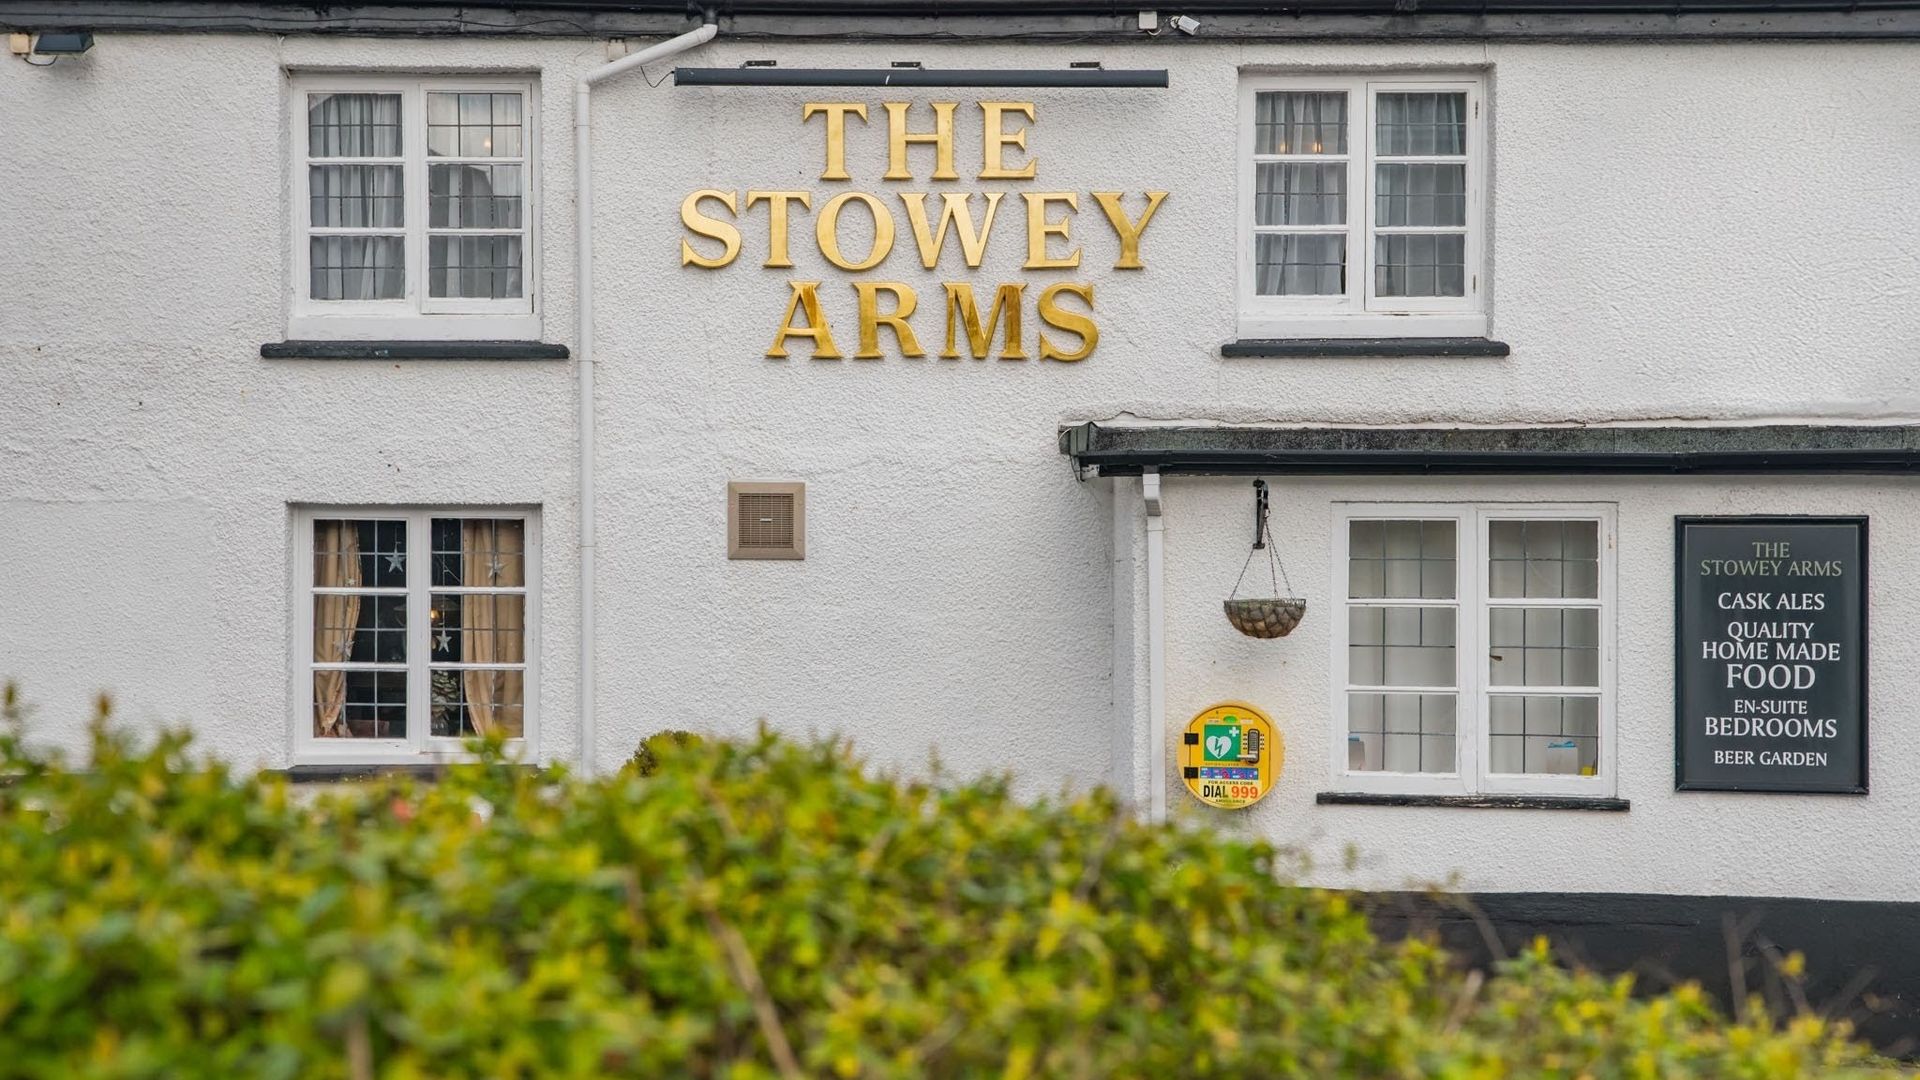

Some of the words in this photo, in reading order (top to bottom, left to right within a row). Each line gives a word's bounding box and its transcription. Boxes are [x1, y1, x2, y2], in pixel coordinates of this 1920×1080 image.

[803, 101, 1038, 181] THE
[680, 190, 1170, 271] STOWEY
[765, 281, 1100, 362] ARMS
[1752, 542, 1790, 558] THE
[1700, 560, 1781, 577] STOWEY
[1787, 560, 1842, 577] ARMS
[1717, 592, 1771, 610] CASK
[1776, 593, 1824, 611] ALES
[1727, 621, 1814, 642] QUALITY
[1702, 641, 1768, 660] HOME
[1775, 643, 1841, 661] MADE
[1726, 663, 1816, 690] FOOD
[1734, 700, 1808, 715] EN-SUITE
[1705, 717, 1838, 738] BEDROOMS
[1714, 750, 1755, 765] BEER
[1759, 751, 1827, 767] GARDEN
[1203, 785, 1229, 797] DIAL
[1231, 786, 1258, 799] 999
